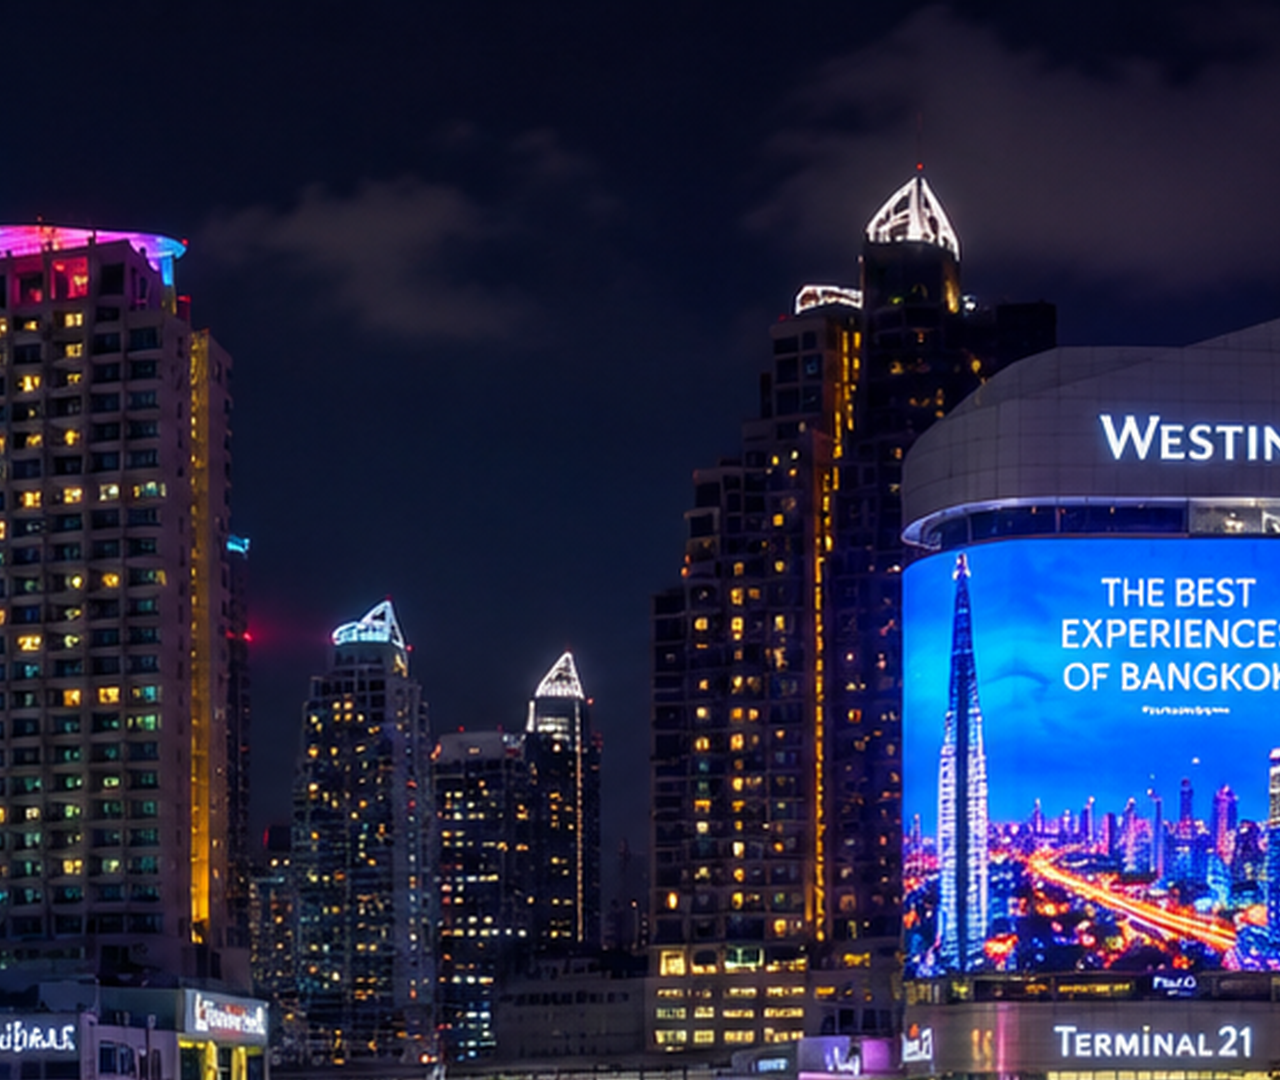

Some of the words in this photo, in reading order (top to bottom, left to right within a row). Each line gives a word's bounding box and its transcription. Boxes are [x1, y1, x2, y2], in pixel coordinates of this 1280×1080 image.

[1101, 577, 1165, 608] THE
[1175, 577, 1257, 608] BEST
[1063, 661, 1111, 692] OF
[1218, 1025, 1252, 1058] 21
